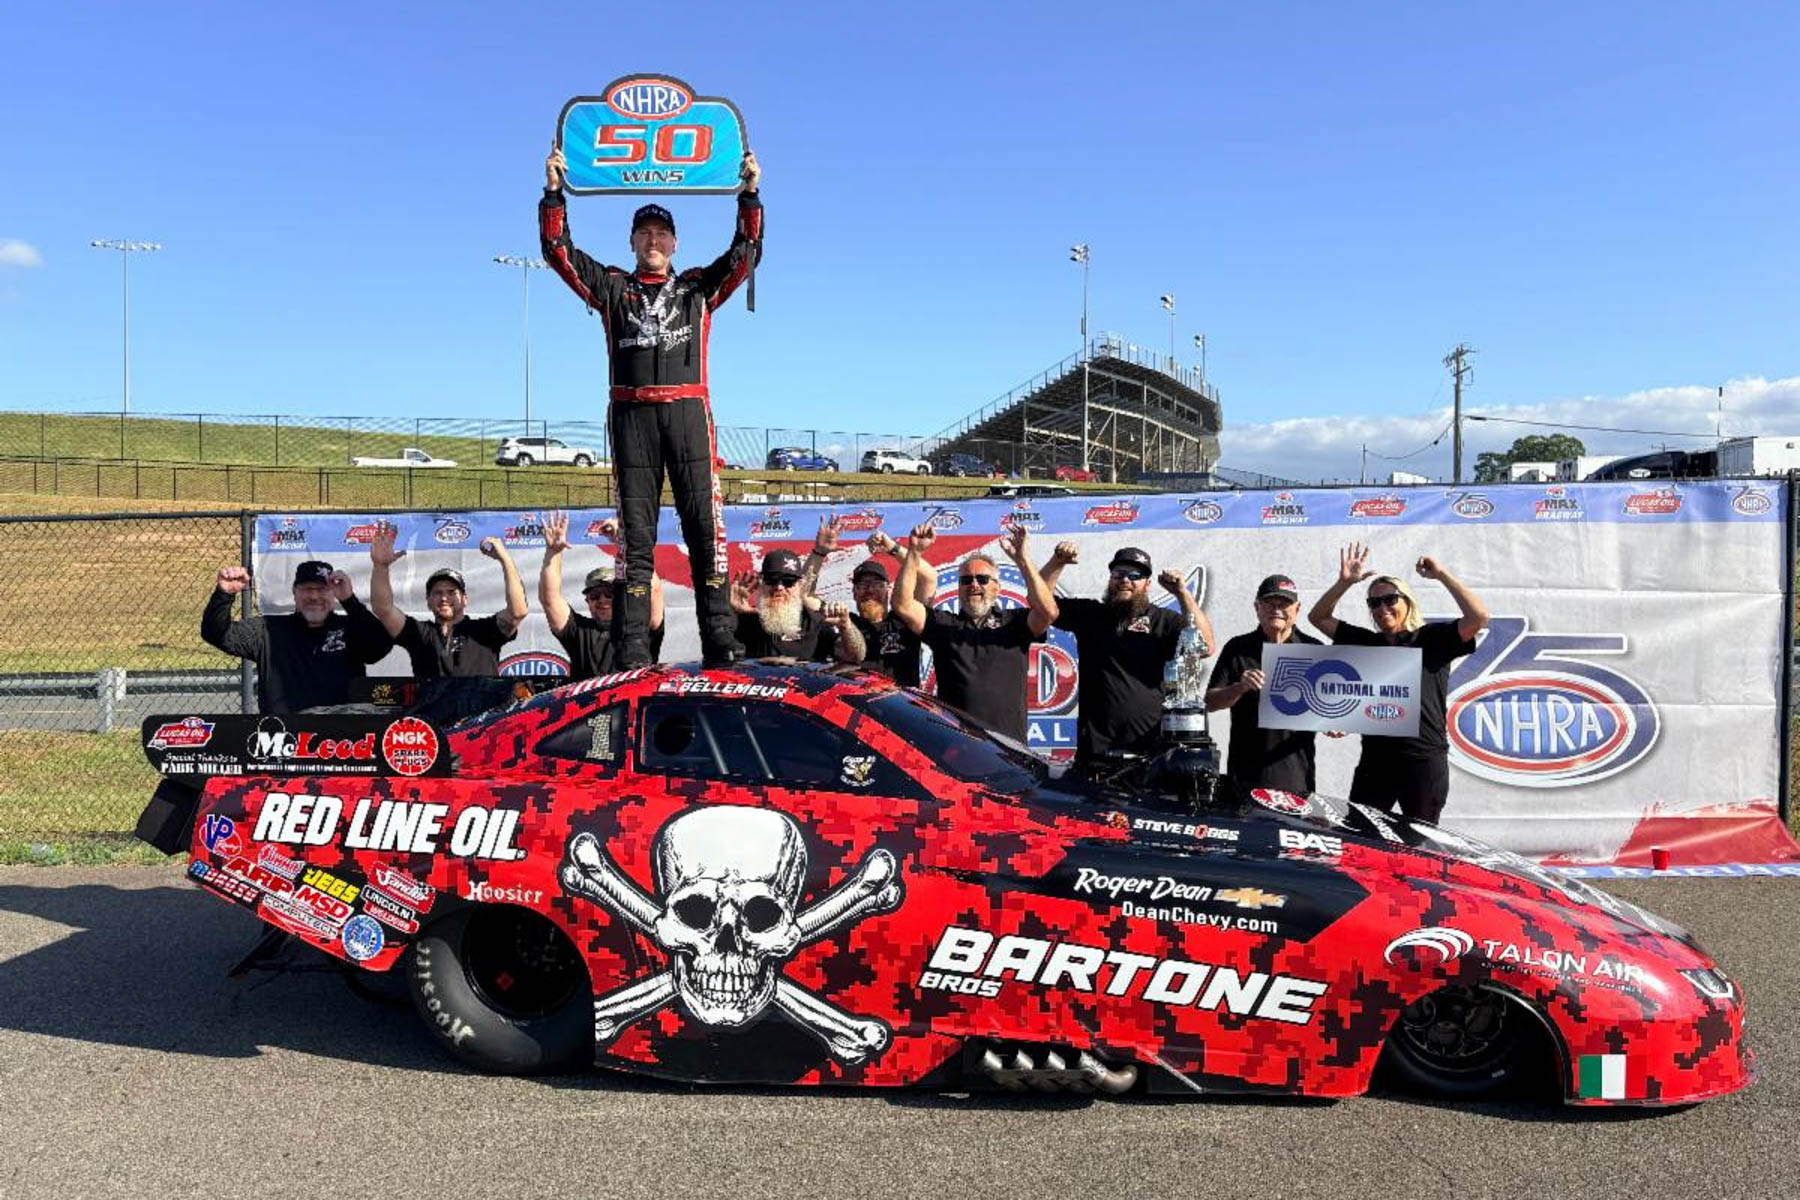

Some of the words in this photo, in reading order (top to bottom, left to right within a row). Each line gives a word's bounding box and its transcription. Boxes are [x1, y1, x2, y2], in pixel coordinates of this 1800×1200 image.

[619, 84, 681, 114] NHRA
[593, 124, 713, 166] 50
[622, 170, 684, 183] WINS
[678, 681, 787, 698] BELLEMEUR
[1270, 657, 1363, 719] 50
[1320, 682, 1374, 697] NATIONAL
[1379, 685, 1410, 698] WINS
[1370, 705, 1402, 720] NHRA
[1474, 693, 1605, 754] NHRA
[253, 731, 377, 759] McLeod
[392, 732, 428, 745] NGK
[586, 714, 615, 760] 1
[160, 761, 195, 774] PARK
[197, 762, 243, 775] MILLER
[206, 814, 235, 852] VP
[251, 791, 344, 846] RED
[344, 797, 450, 854] LINE
[450, 805, 521, 861] OIL
[1132, 818, 1182, 835] STEVE
[1279, 828, 1343, 856] BAE
[221, 856, 295, 896] ARP
[302, 868, 361, 904] JEGS
[1073, 866, 1153, 900] Roger
[1149, 876, 1213, 902] Dean
[296, 887, 349, 919] MSD
[365, 889, 410, 920] LINCOLN
[466, 880, 544, 904] Hoosier
[1121, 901, 1279, 934] DeanChevy.com
[928, 926, 1329, 1024] BARTONE
[1482, 939, 1587, 974] TALON
[1592, 959, 1648, 984] AIR
[918, 970, 1003, 998] BROS
